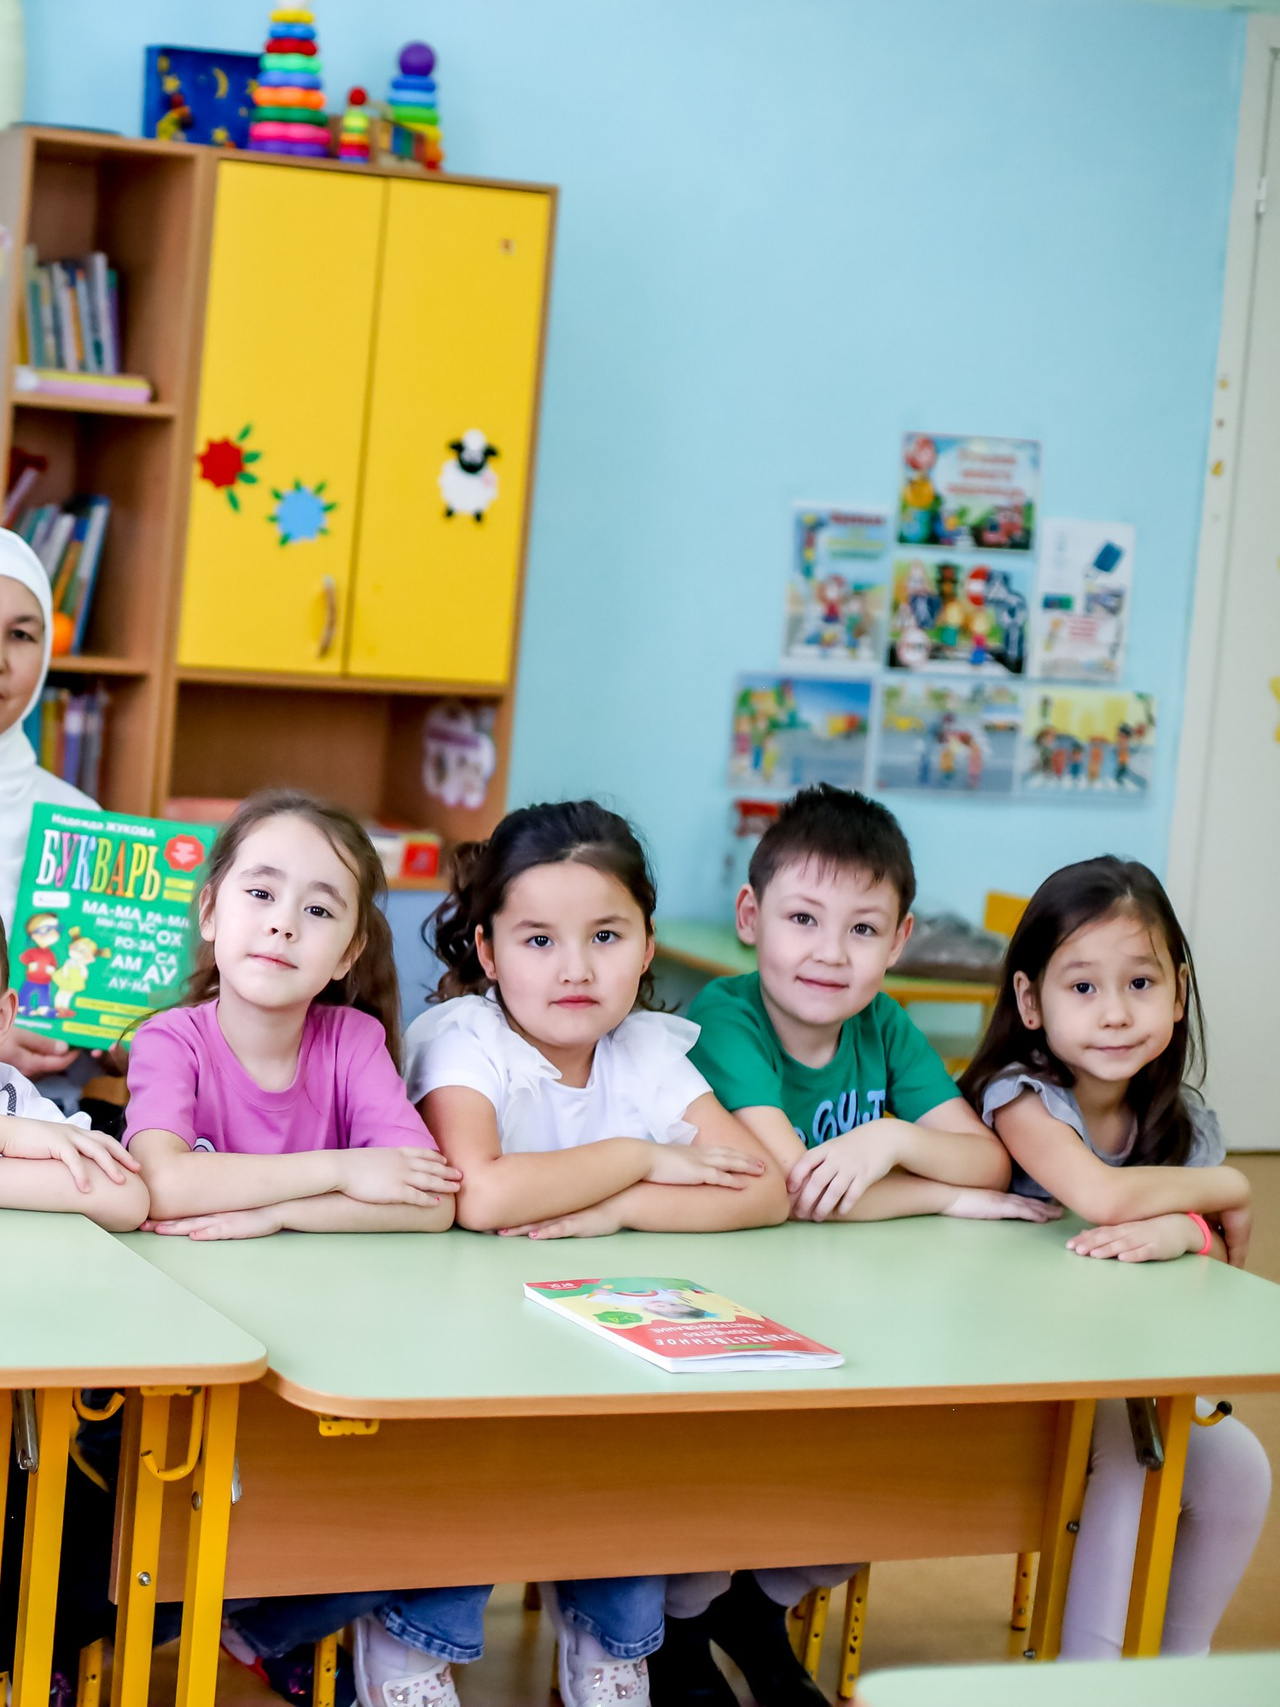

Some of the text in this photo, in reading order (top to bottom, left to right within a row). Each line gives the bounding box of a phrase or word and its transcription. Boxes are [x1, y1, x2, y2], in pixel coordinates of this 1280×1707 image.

[105, 821, 157, 839] ЖУКОВА
[35, 828, 161, 902] БУКВАРЬ
[82, 899, 141, 921] МА-МА
[114, 936, 157, 953] РО-ЗА
[110, 954, 143, 971] АМ
[142, 964, 178, 986] АУ
